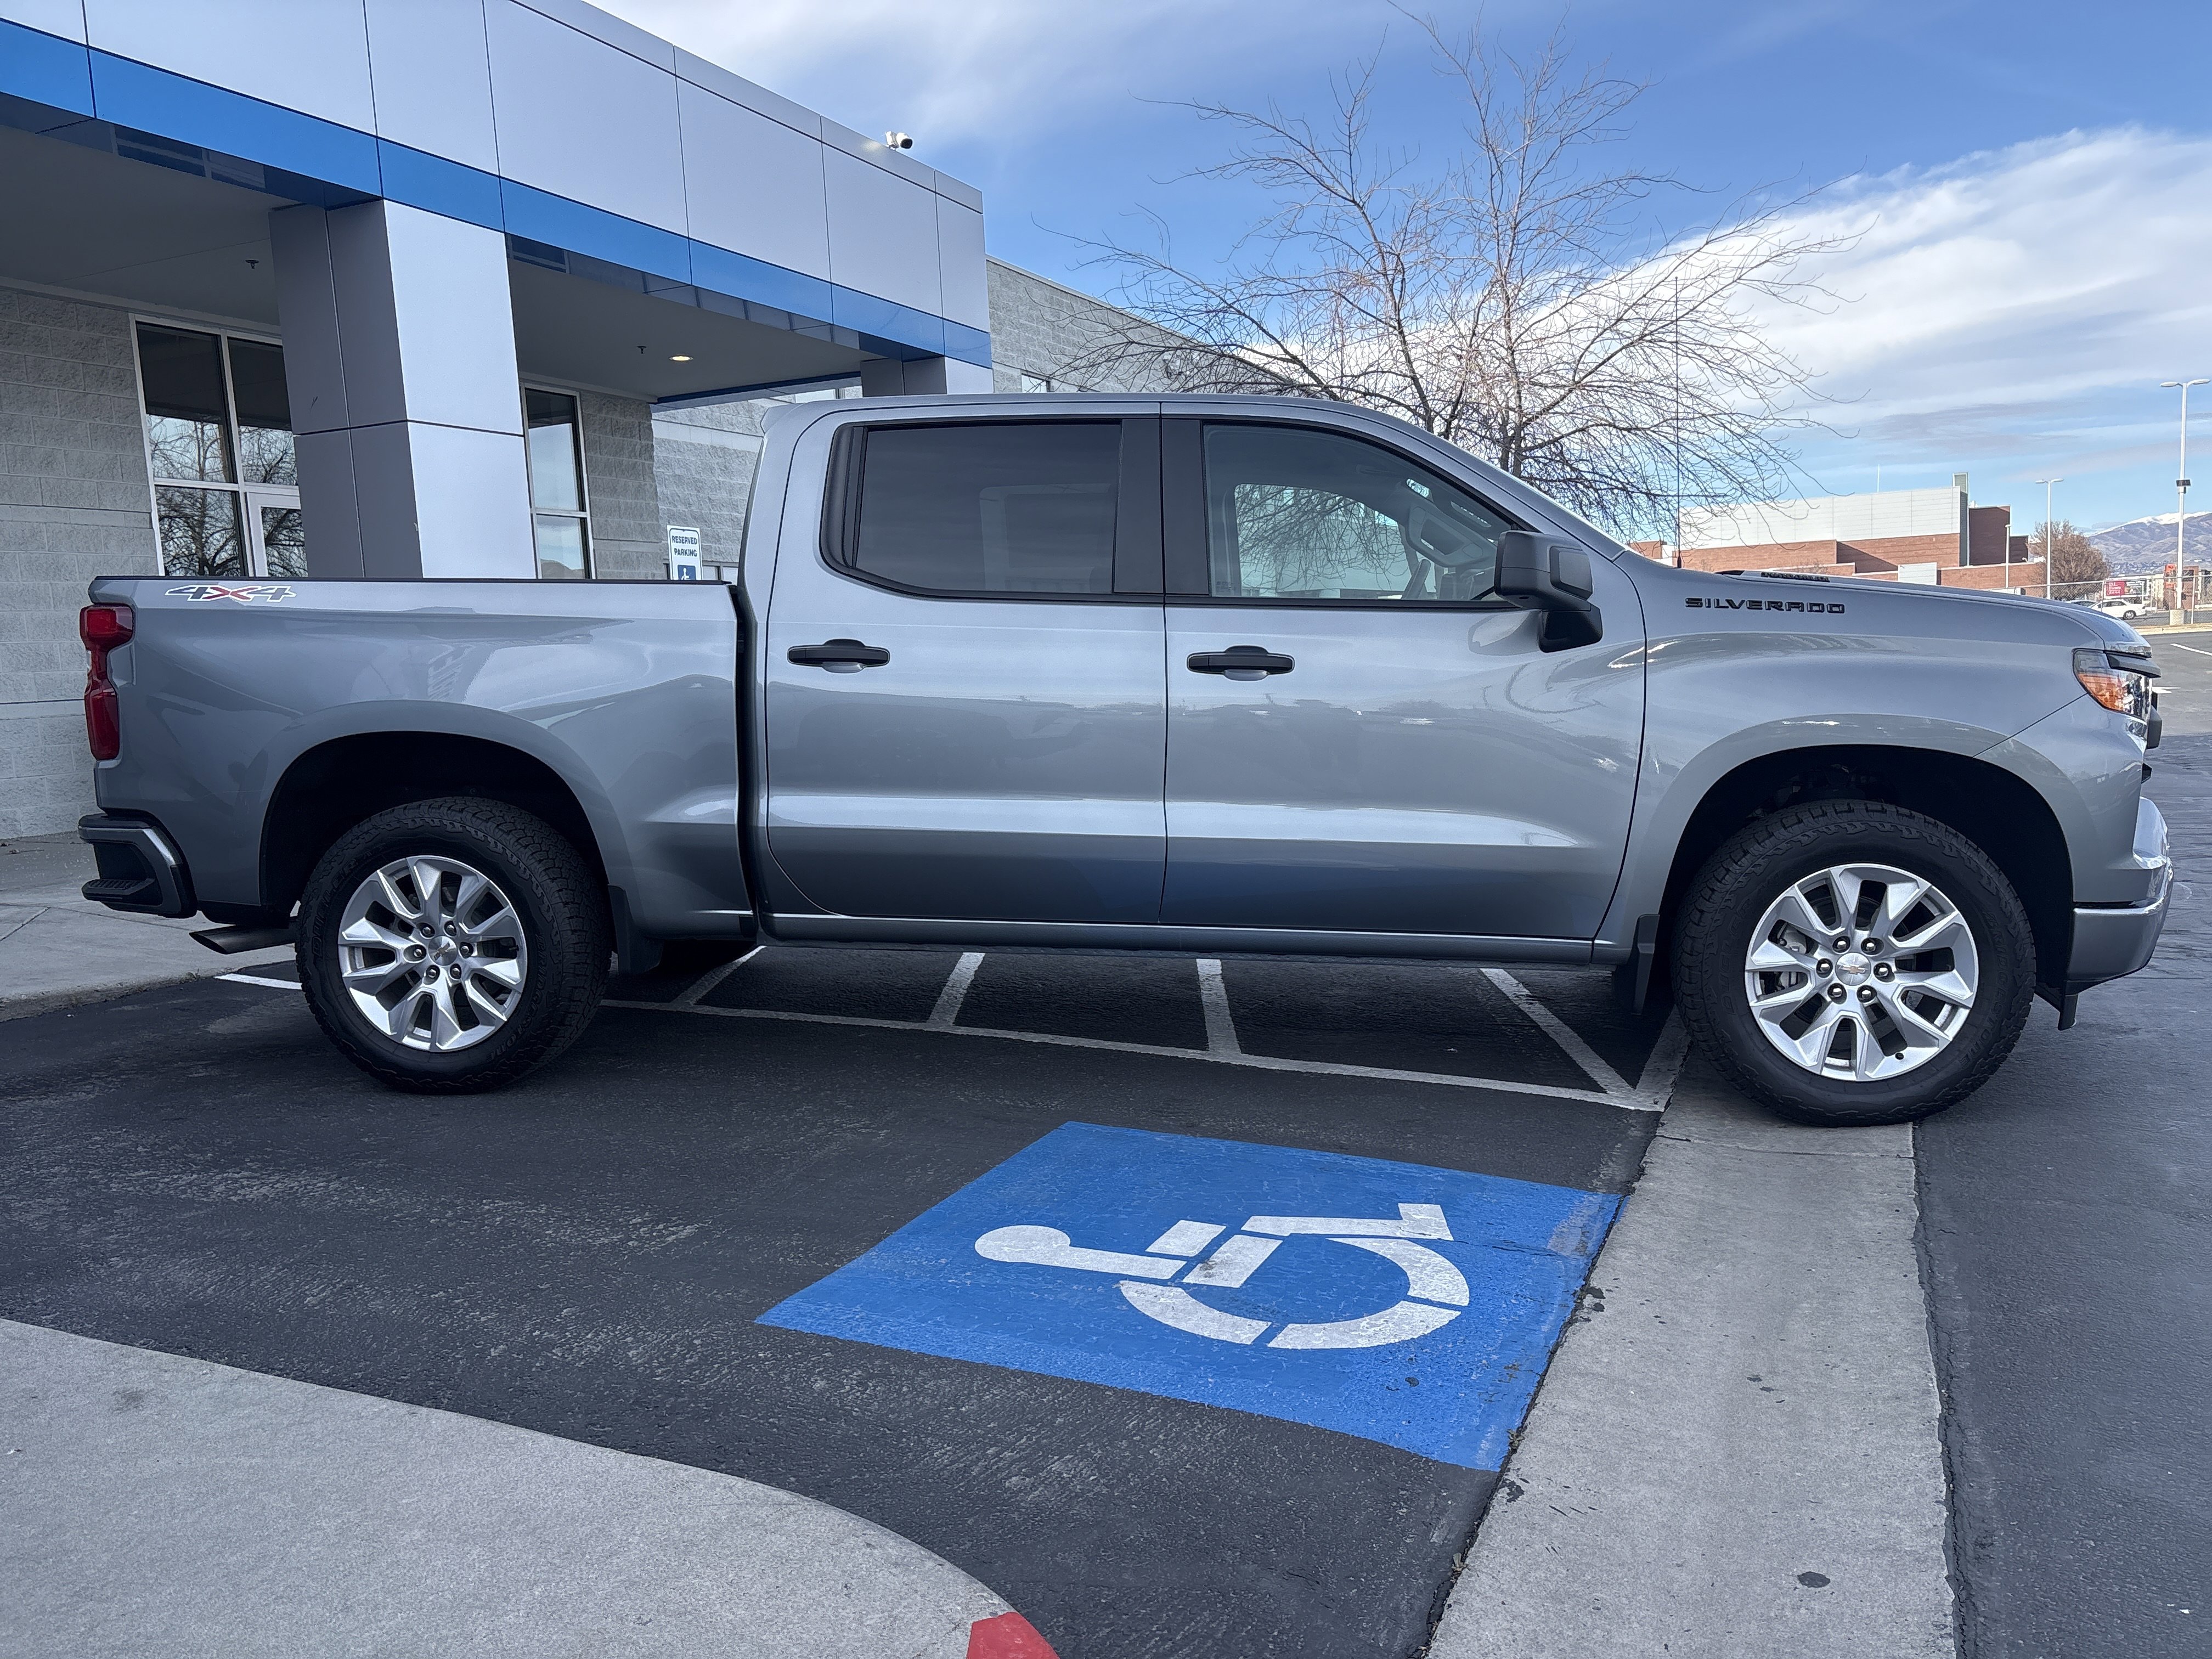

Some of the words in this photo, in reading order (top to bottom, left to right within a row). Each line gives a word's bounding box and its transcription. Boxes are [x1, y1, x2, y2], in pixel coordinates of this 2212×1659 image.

[672, 535, 697, 545] RESERVED
[674, 548, 697, 557] PARKING
[1685, 597, 1845, 613] SILVERADO
[1959, 911, 2009, 1069] BRIDGESTONE
